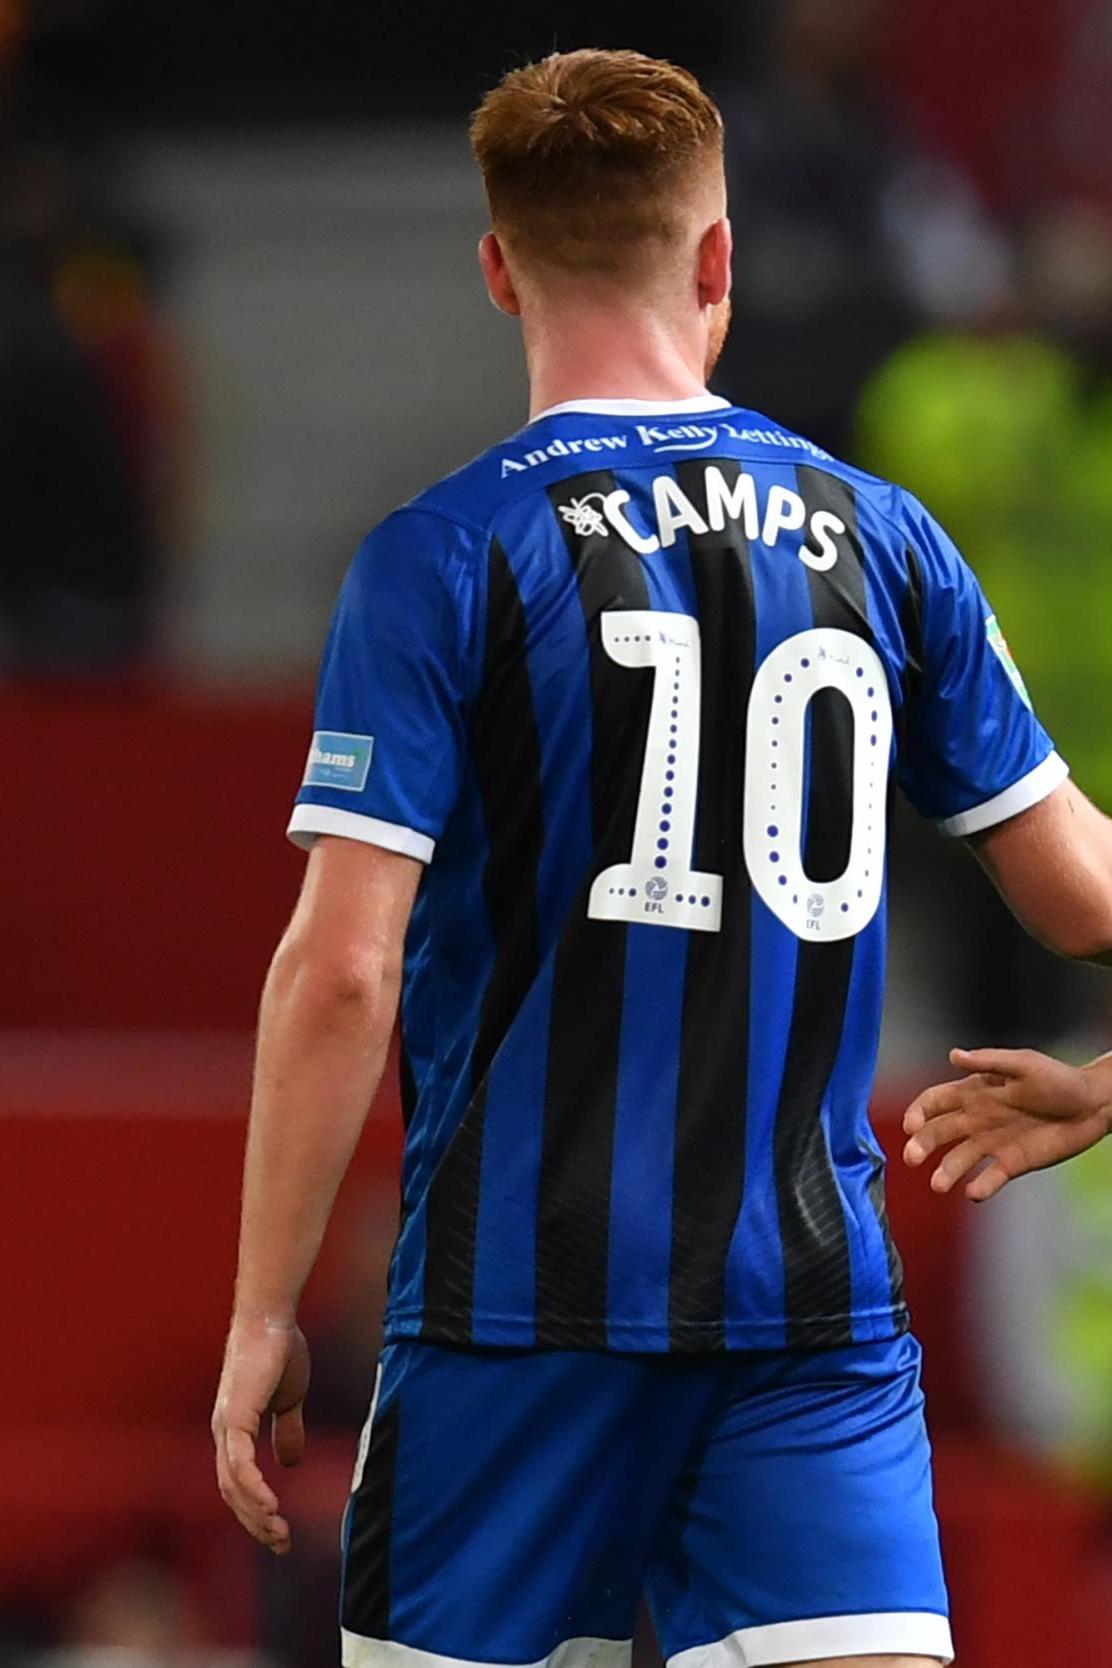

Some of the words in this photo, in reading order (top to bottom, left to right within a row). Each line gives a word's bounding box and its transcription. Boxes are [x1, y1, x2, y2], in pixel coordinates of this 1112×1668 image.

[500, 435, 628, 479] Andrew
[636, 425, 717, 451] Kelly
[603, 466, 846, 572] CAMPS
[587, 610, 893, 942] 10
[644, 902, 664, 914] EFL
